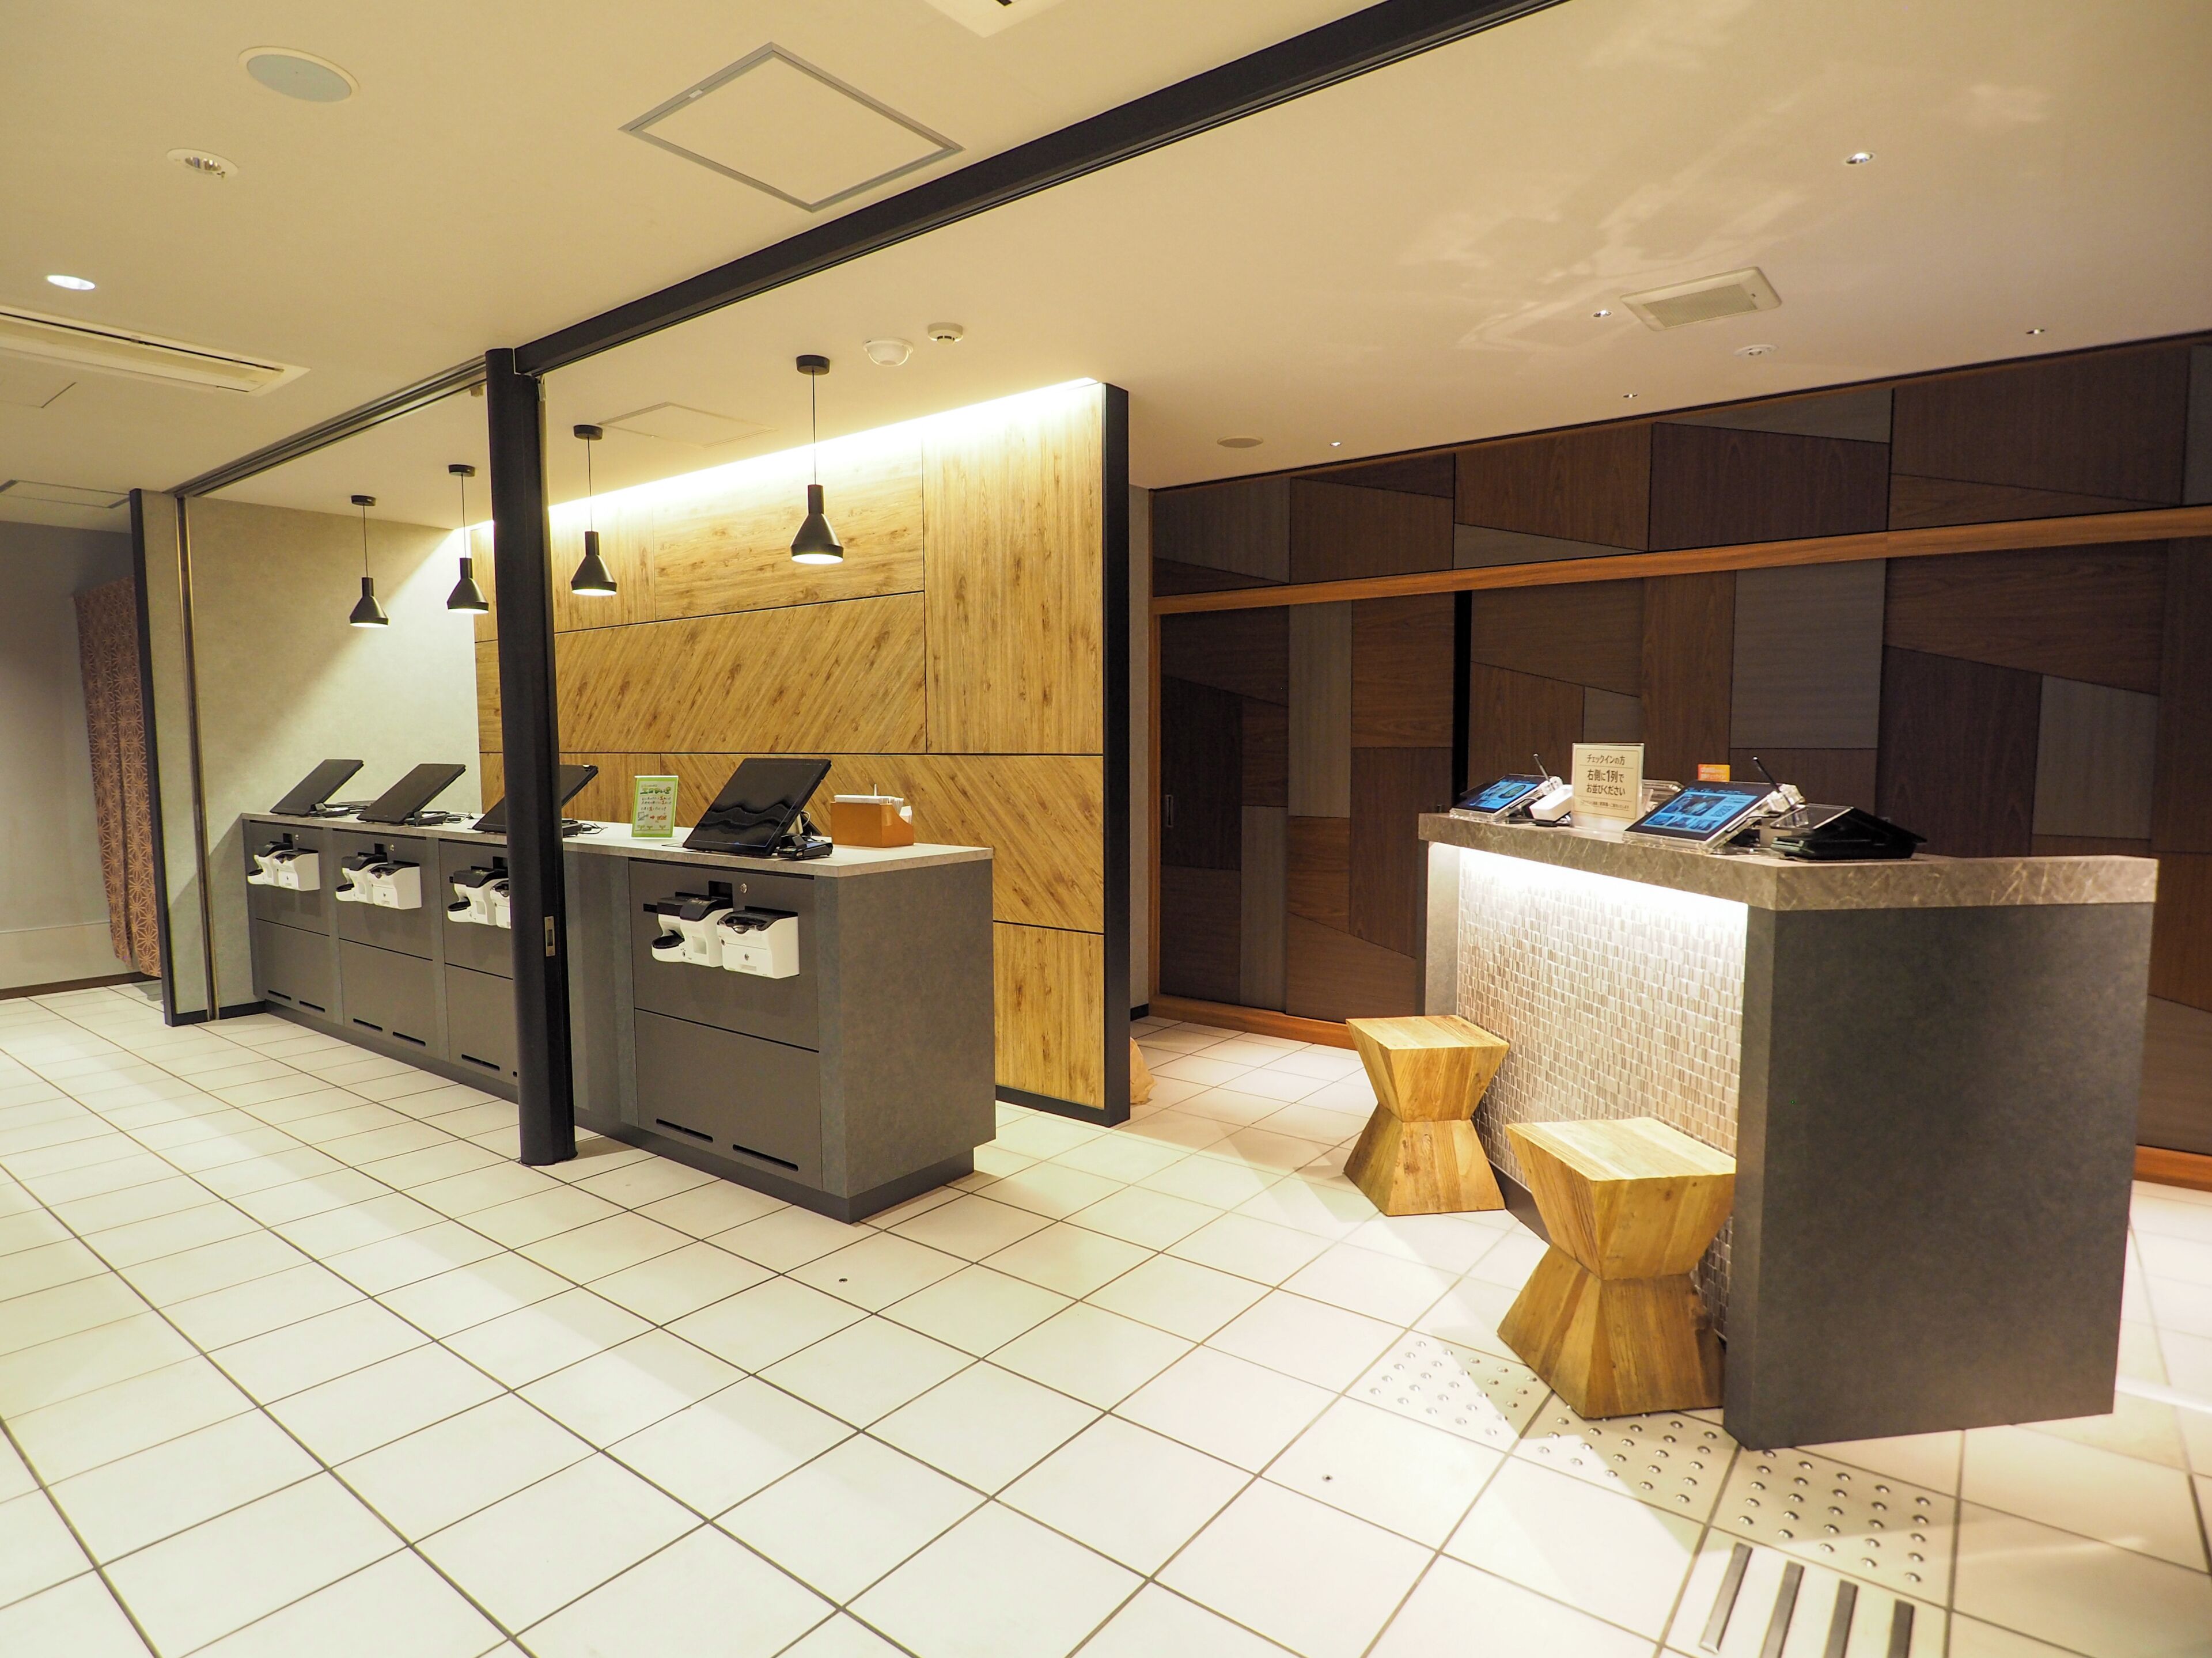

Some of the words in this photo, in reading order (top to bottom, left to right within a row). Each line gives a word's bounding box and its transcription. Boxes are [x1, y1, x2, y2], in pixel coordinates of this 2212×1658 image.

[1587, 753, 1625, 765] チェックインの方
[1587, 769, 1624, 783] 右側に1列で
[1586, 783, 1626, 796] お並びください
